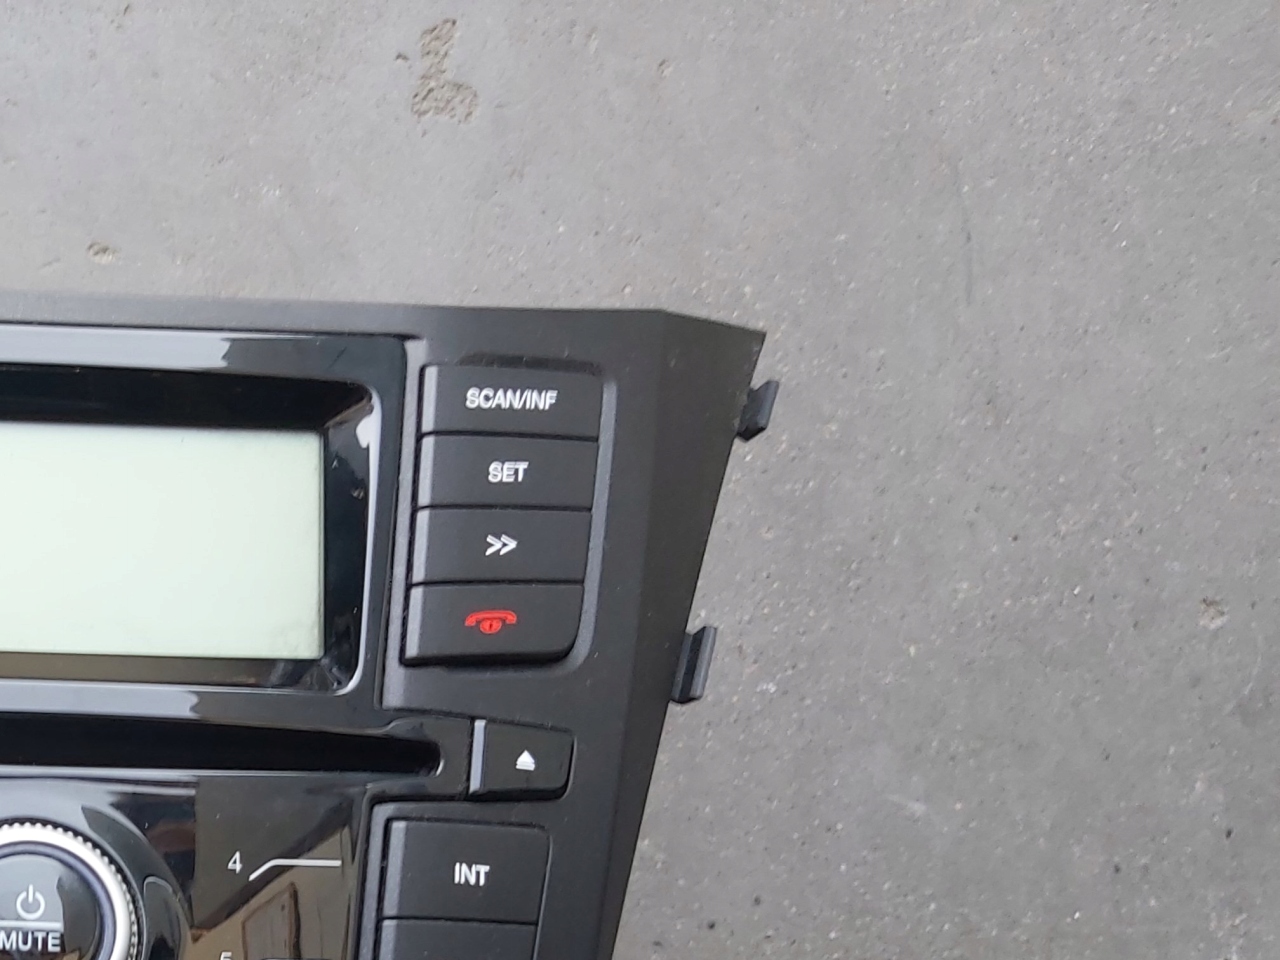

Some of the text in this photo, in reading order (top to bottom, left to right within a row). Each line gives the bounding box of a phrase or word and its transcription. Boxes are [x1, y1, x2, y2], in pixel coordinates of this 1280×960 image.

[465, 387, 558, 410] SCAN/INF
[488, 461, 529, 483] SET
[227, 851, 242, 874] 4
[454, 862, 490, 886] INT
[0, 931, 62, 952] MUTE
